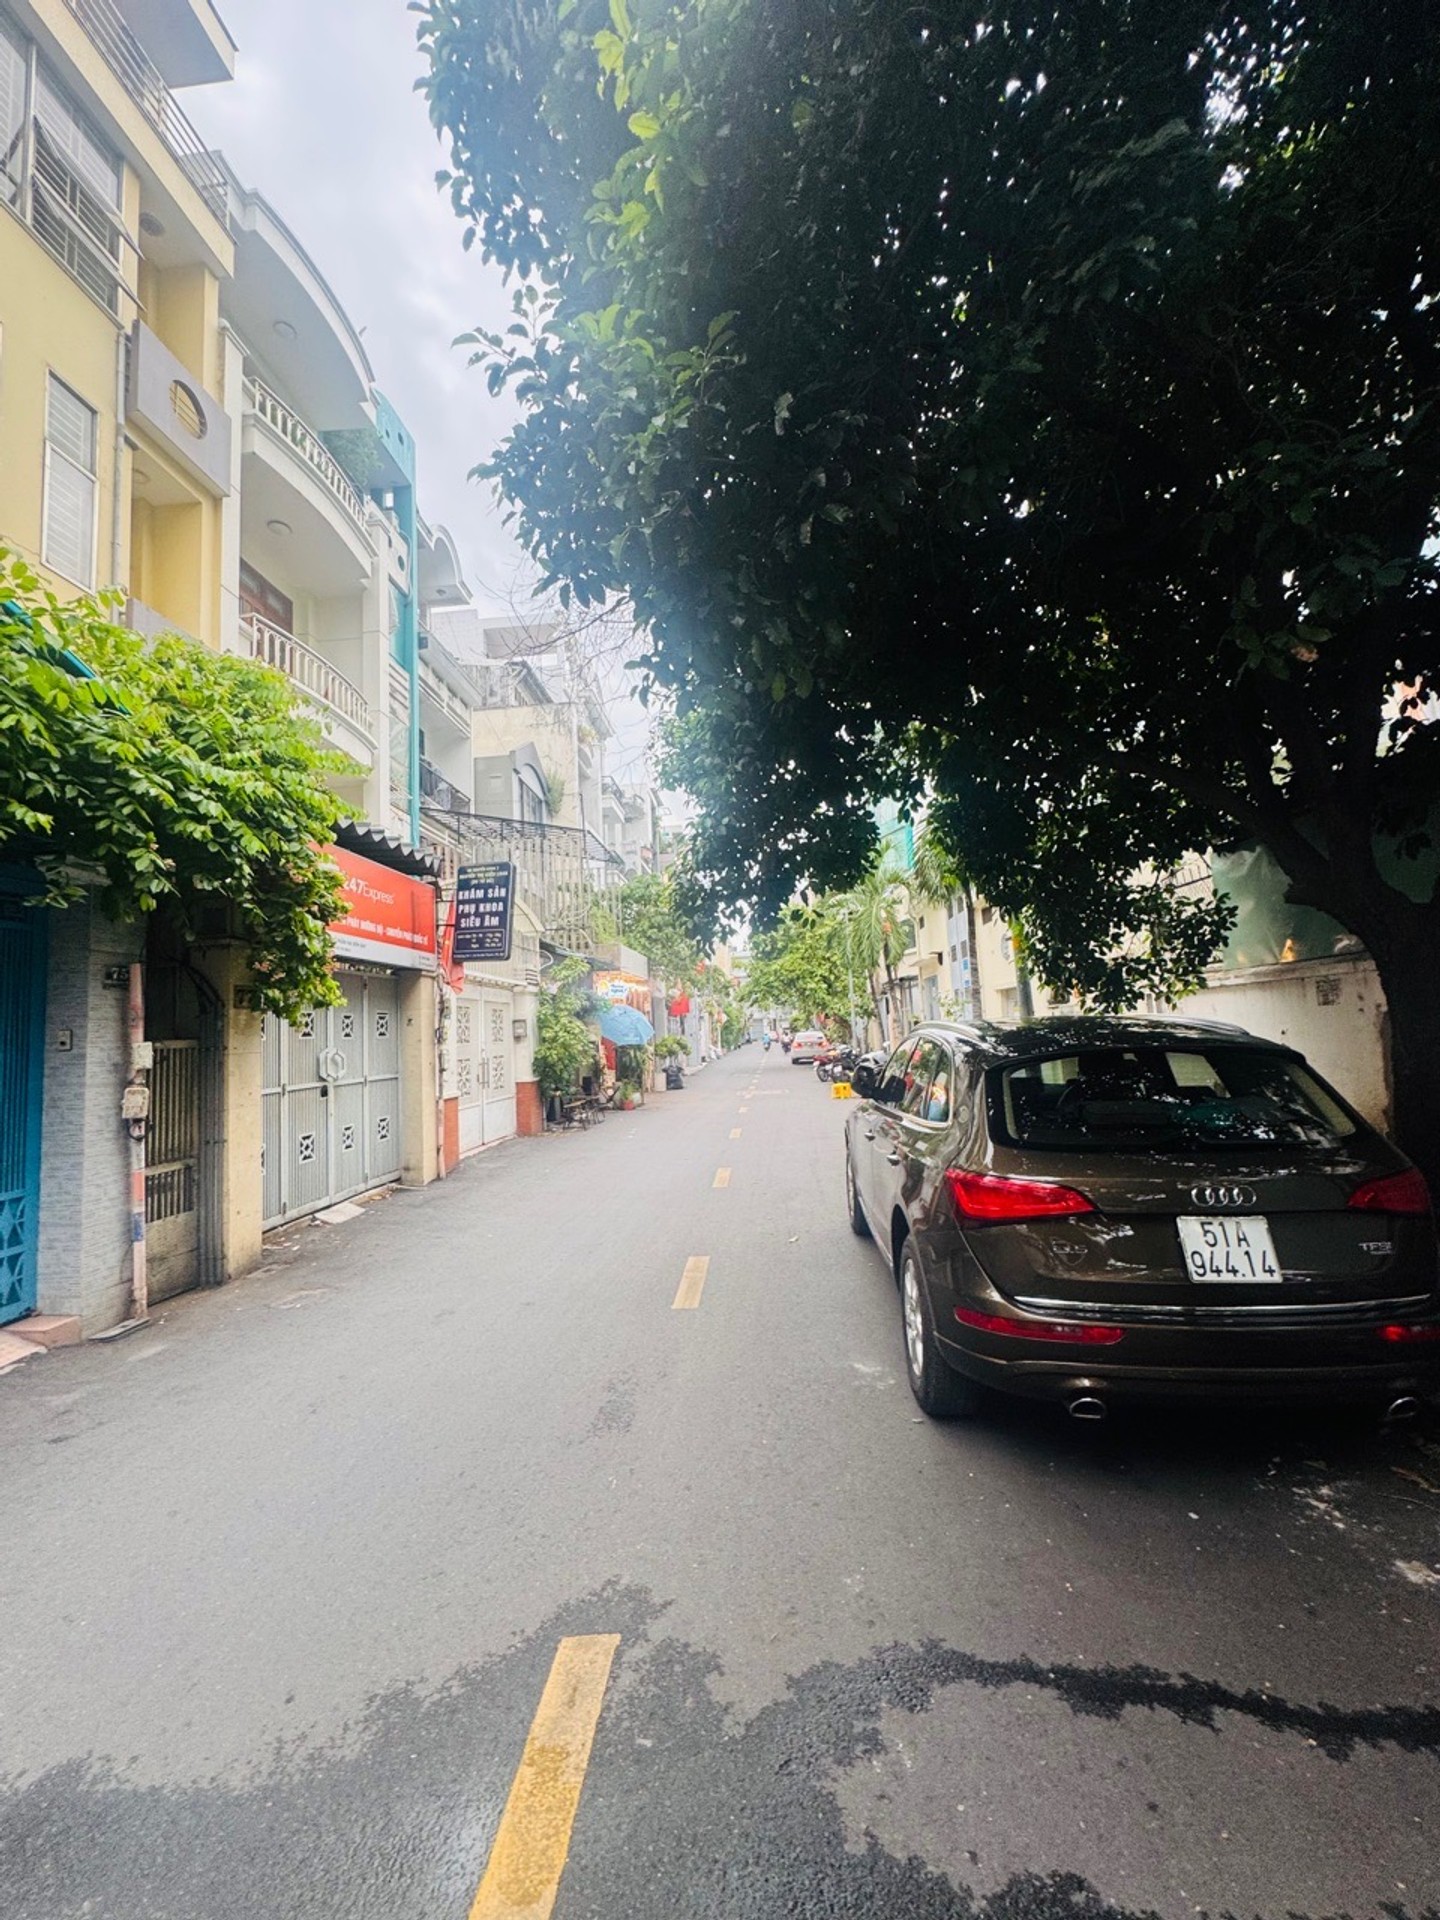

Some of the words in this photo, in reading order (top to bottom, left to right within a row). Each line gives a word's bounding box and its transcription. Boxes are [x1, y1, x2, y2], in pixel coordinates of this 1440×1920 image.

[458, 887, 485, 900] KHÁM
[458, 903, 476, 915] PHỤ
[479, 902, 504, 913] KHOA
[460, 915, 481, 928] SIÊU
[484, 914, 500, 926] ÂM
[111, 967, 129, 980] 75
[1200, 1221, 1251, 1248] 51A
[1190, 1250, 1276, 1278] 944.14
